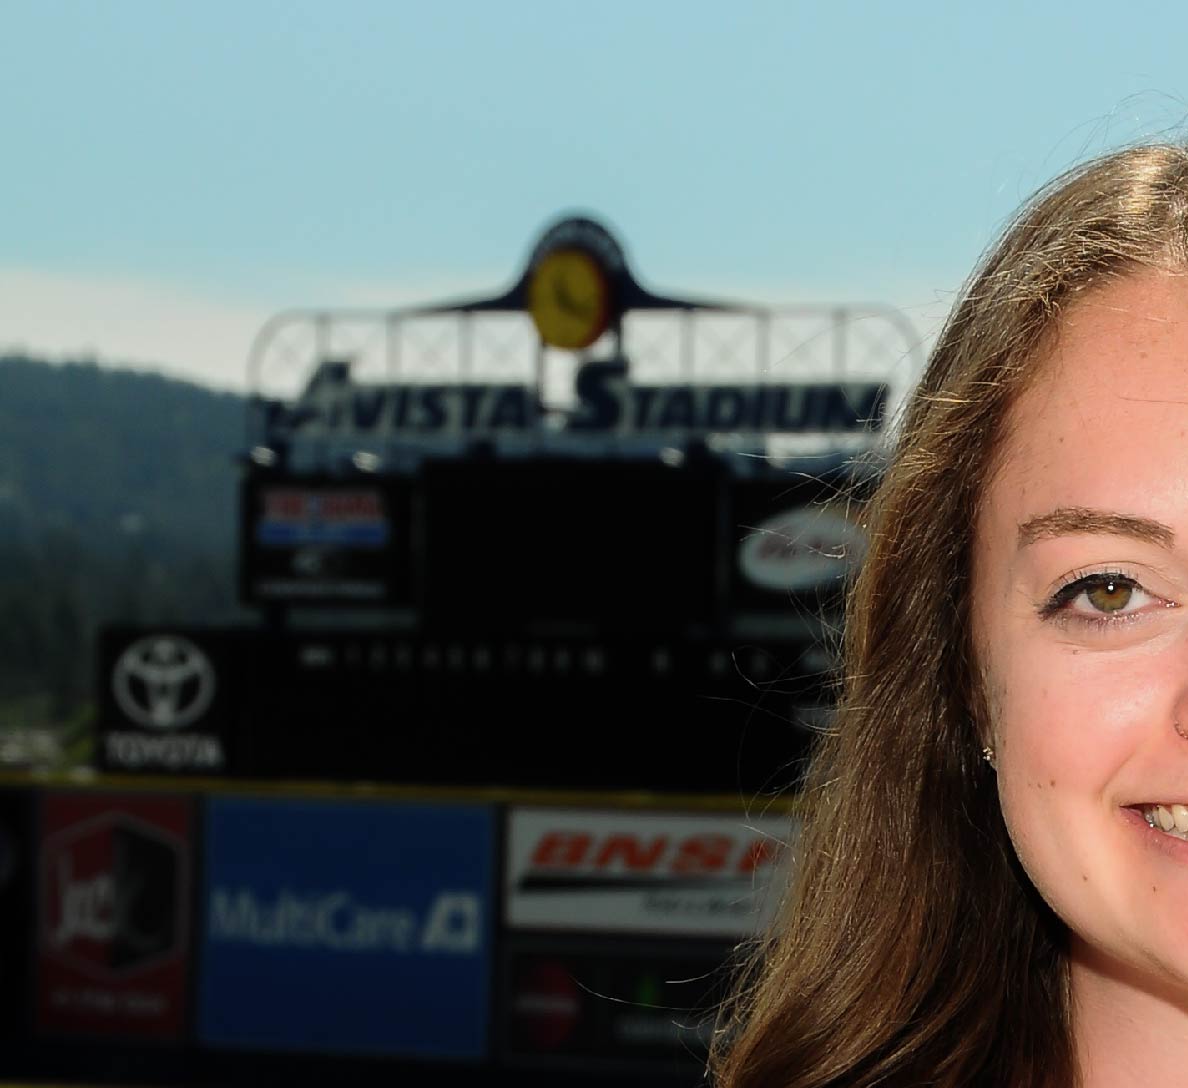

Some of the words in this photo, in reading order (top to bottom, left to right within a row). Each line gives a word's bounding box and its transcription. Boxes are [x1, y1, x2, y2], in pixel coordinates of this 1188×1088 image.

[572, 360, 885, 431] STADIUM
[103, 732, 226, 768] TOYOTA
[208, 885, 414, 955] MultiCare
